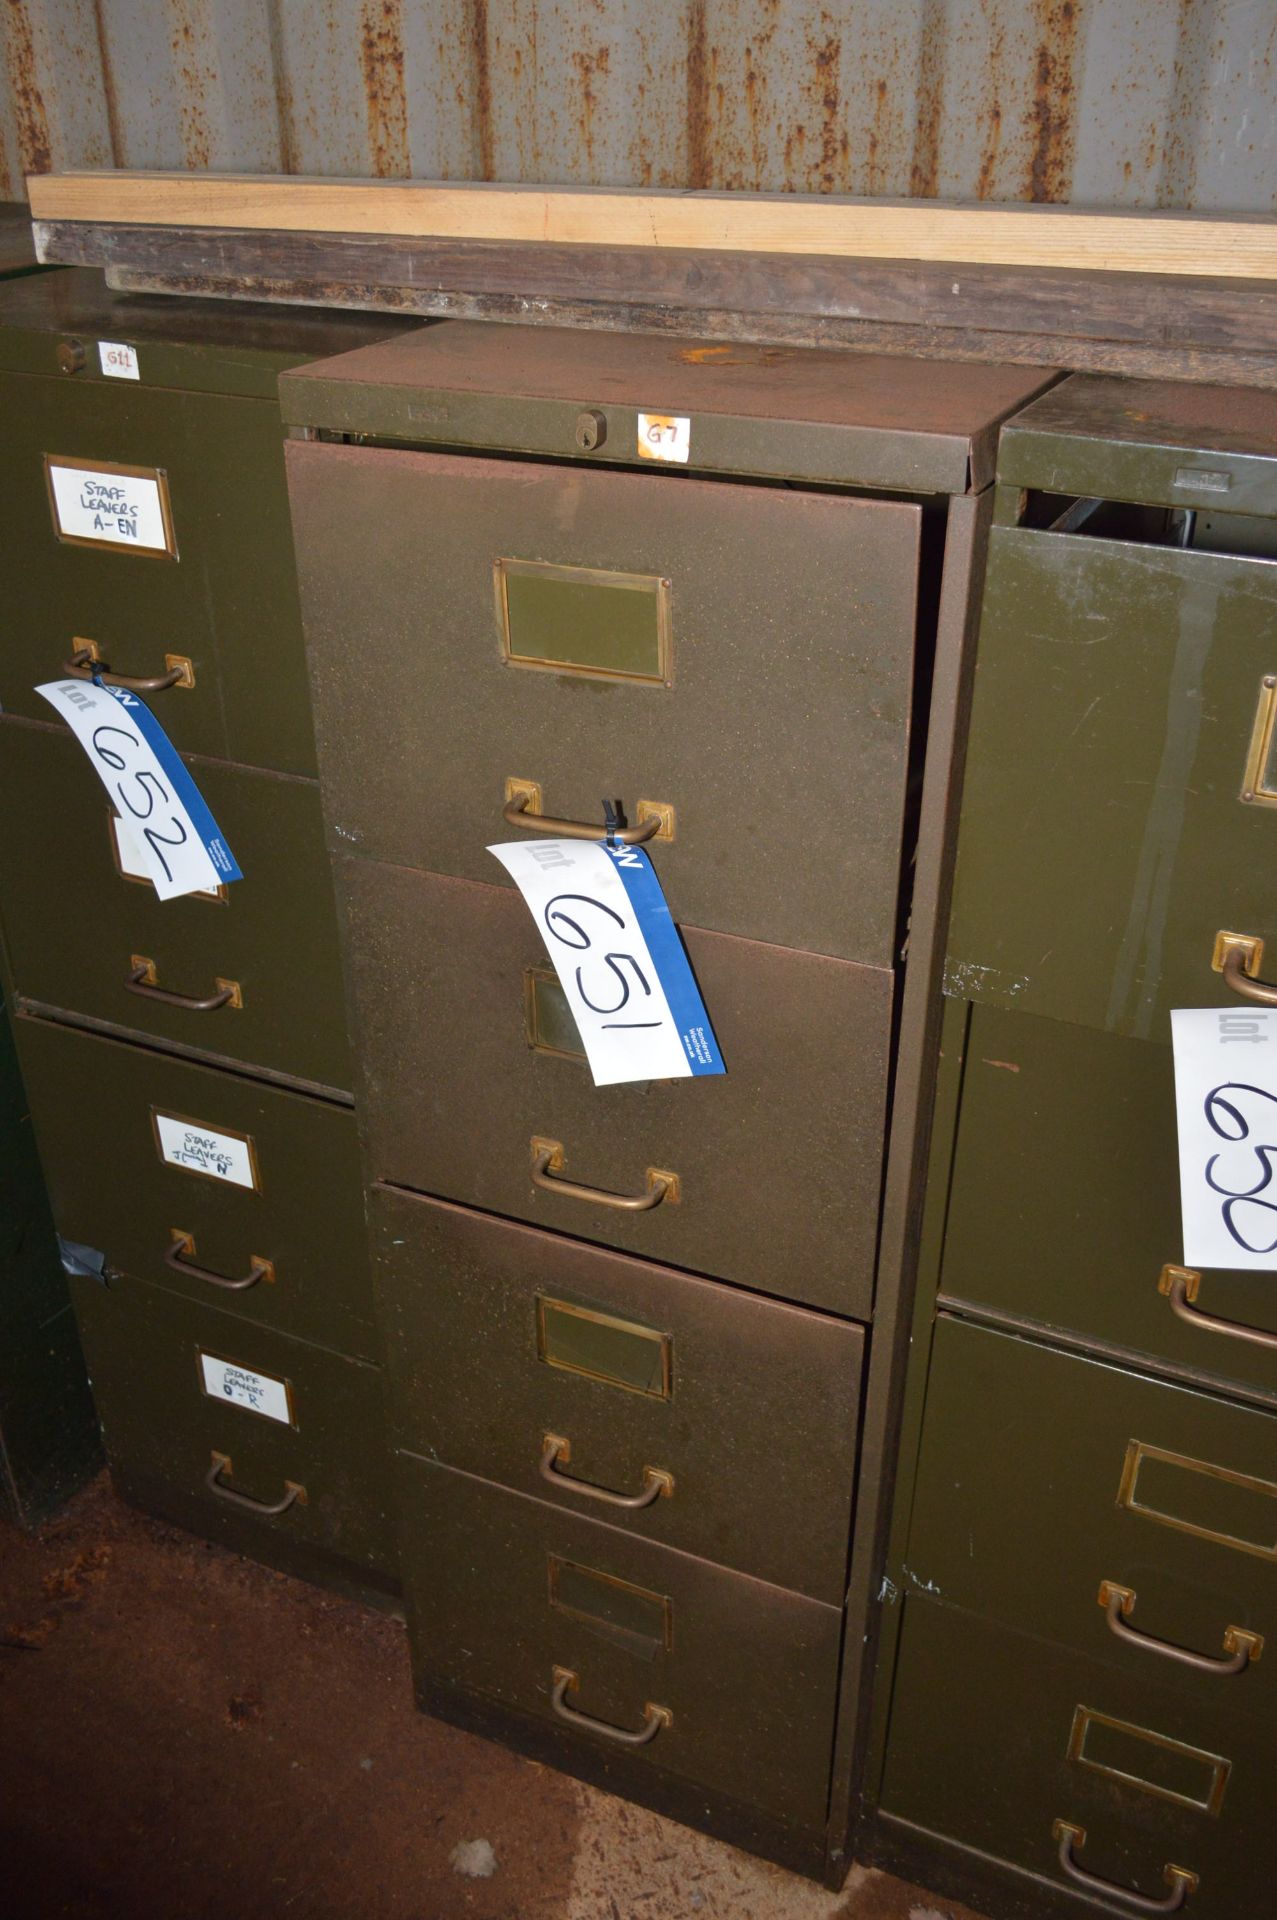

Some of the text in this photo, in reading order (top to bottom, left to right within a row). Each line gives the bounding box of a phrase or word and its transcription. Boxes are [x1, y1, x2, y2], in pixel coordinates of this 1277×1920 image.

[646, 422, 678, 443] G7
[83, 480, 126, 501] STAFF
[80, 493, 139, 518] LEAVERS
[57, 684, 99, 712] Lot
[92, 725, 188, 883] 652
[525, 843, 577, 871] Lot
[544, 893, 663, 1030] 651
[1218, 1014, 1269, 1044] Lot
[696, 1027, 713, 1063] Sanderson
[183, 1141, 233, 1167] LEAVERS
[184, 1132, 218, 1150] STAFF
[1203, 1081, 1277, 1254] 650
[223, 1373, 265, 1397] LEAVERS
[225, 1367, 261, 1384] STAFF
